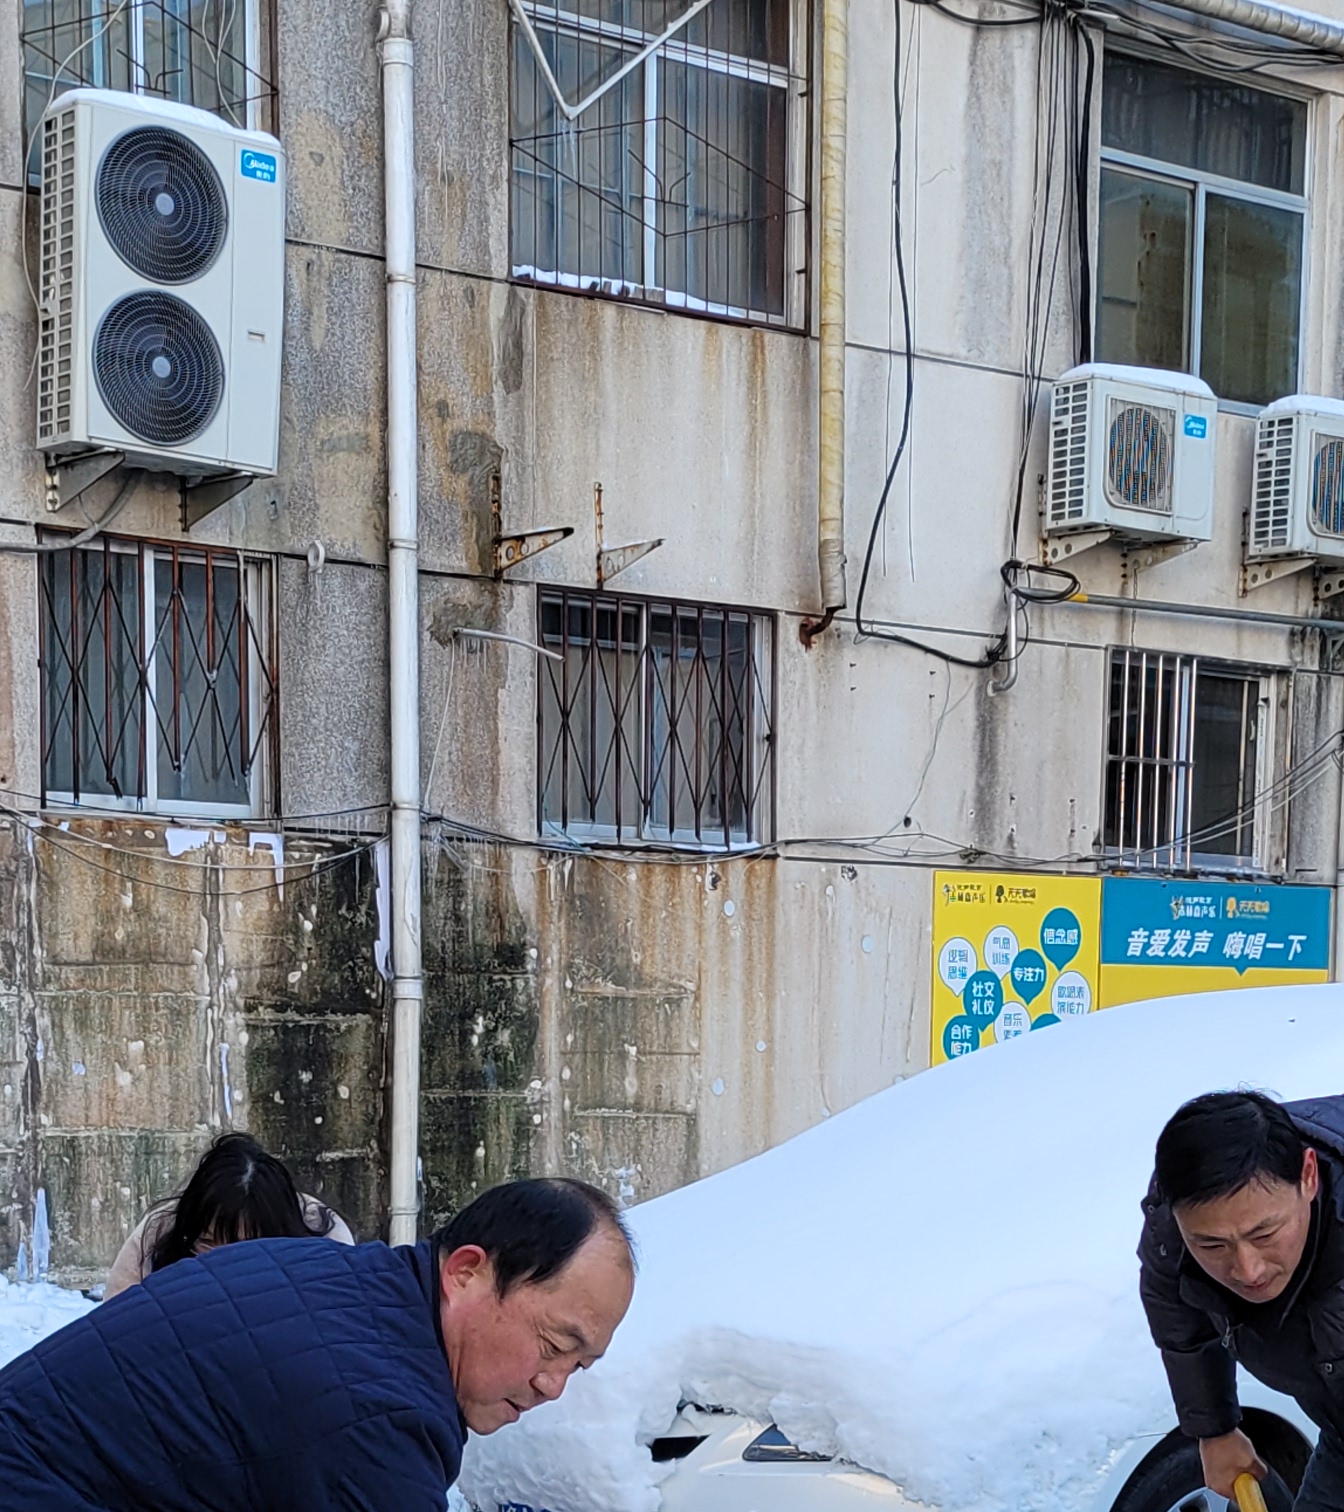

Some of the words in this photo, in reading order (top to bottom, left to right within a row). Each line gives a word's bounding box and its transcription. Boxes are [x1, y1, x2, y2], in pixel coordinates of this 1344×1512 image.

[1044, 928, 1079, 945] 信念感
[1126, 927, 1214, 959] 音爱发声
[1223, 930, 1308, 961] 嗨唱一下
[1013, 966, 1044, 982] 专注力
[972, 981, 996, 998] 社交
[972, 999, 995, 1016] 礼仪
[1003, 1013, 1023, 1027] 音乐
[951, 1024, 973, 1040] 合作
